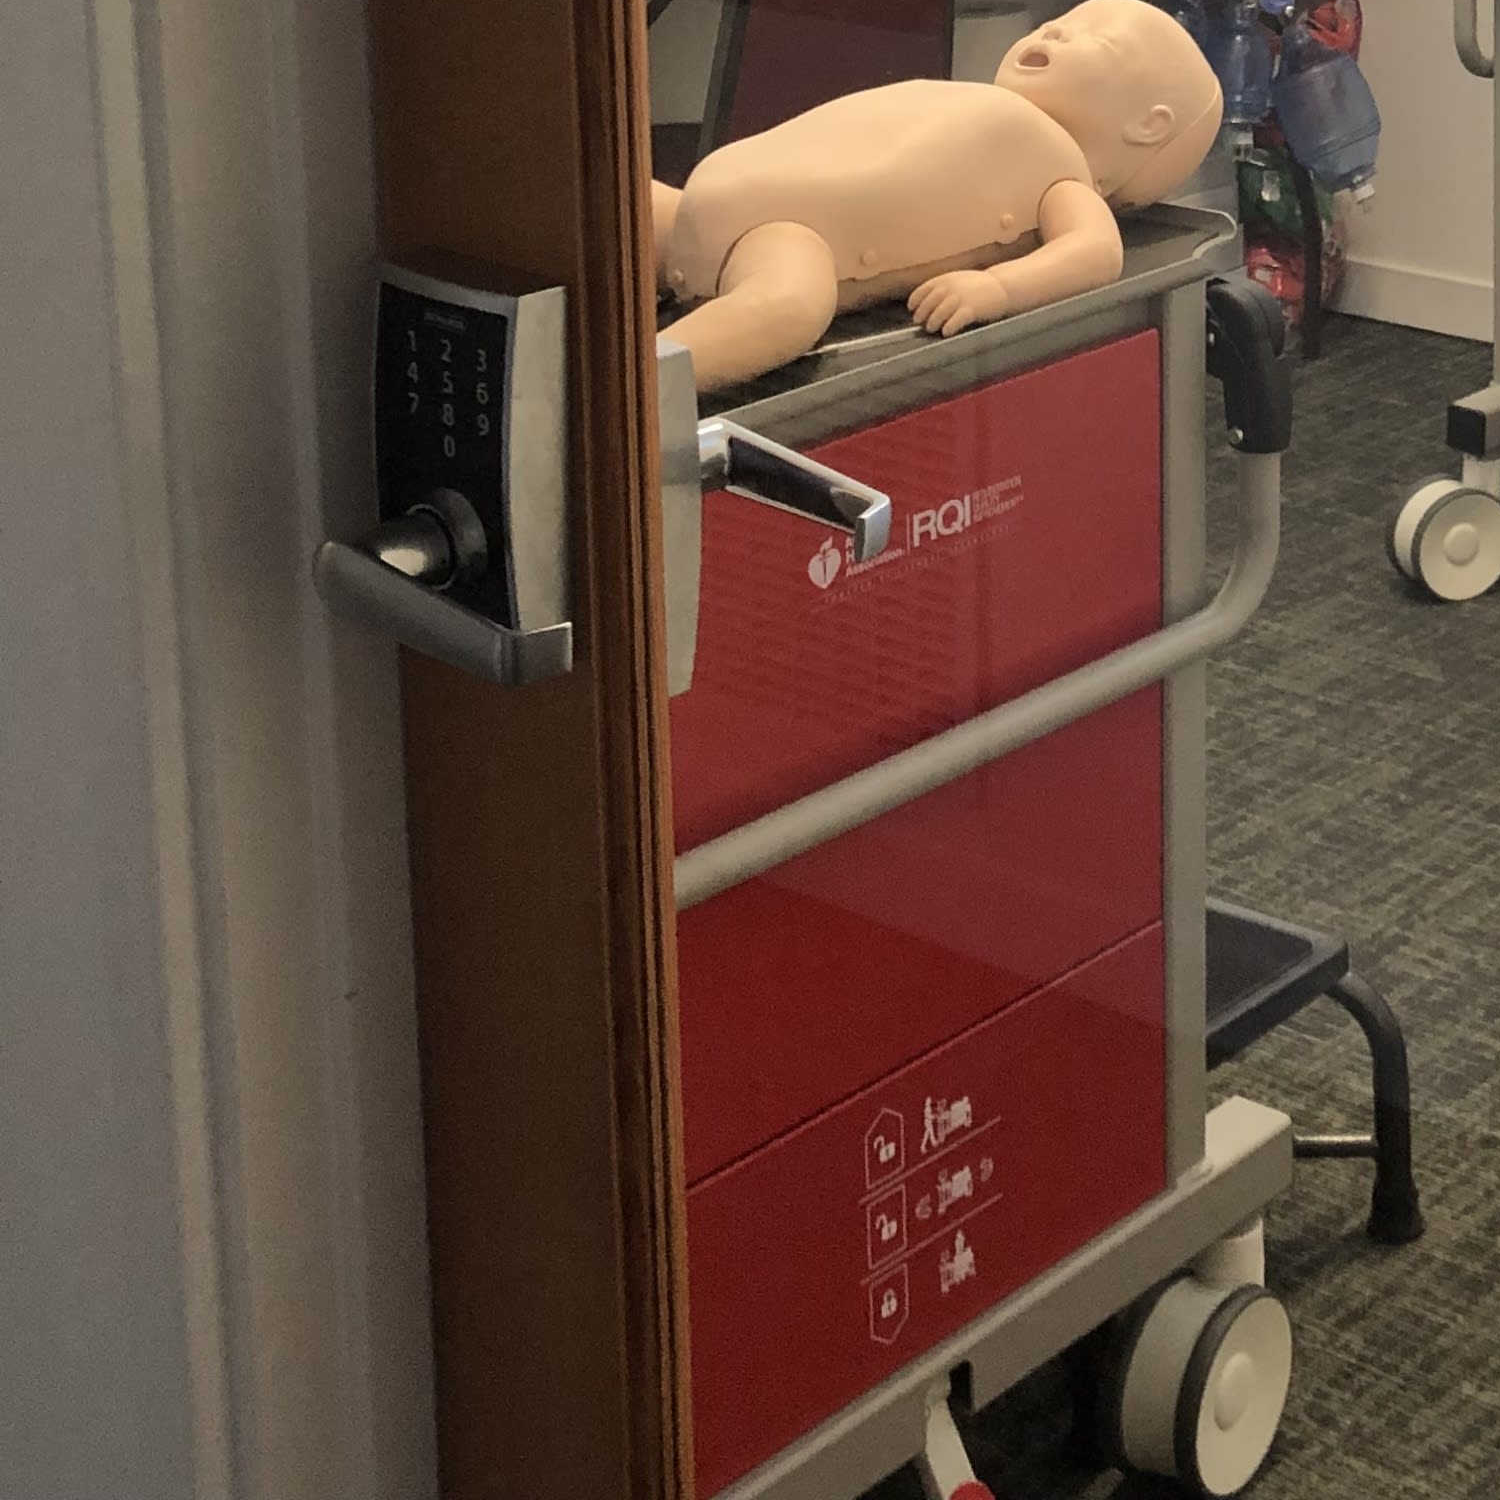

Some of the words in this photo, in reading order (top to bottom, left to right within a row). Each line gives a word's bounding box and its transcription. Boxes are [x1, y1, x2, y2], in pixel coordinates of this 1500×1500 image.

[407, 330, 417, 352] 1
[440, 339, 451, 363] 2
[476, 349, 487, 372] 3
[406, 361, 419, 384] 4
[442, 371, 453, 394] 5
[476, 382, 489, 405] 6
[407, 392, 419, 414] 7
[443, 403, 454, 426] 8
[477, 414, 490, 436] 9
[444, 435, 456, 458] 0
[912, 494, 972, 547] RQI
